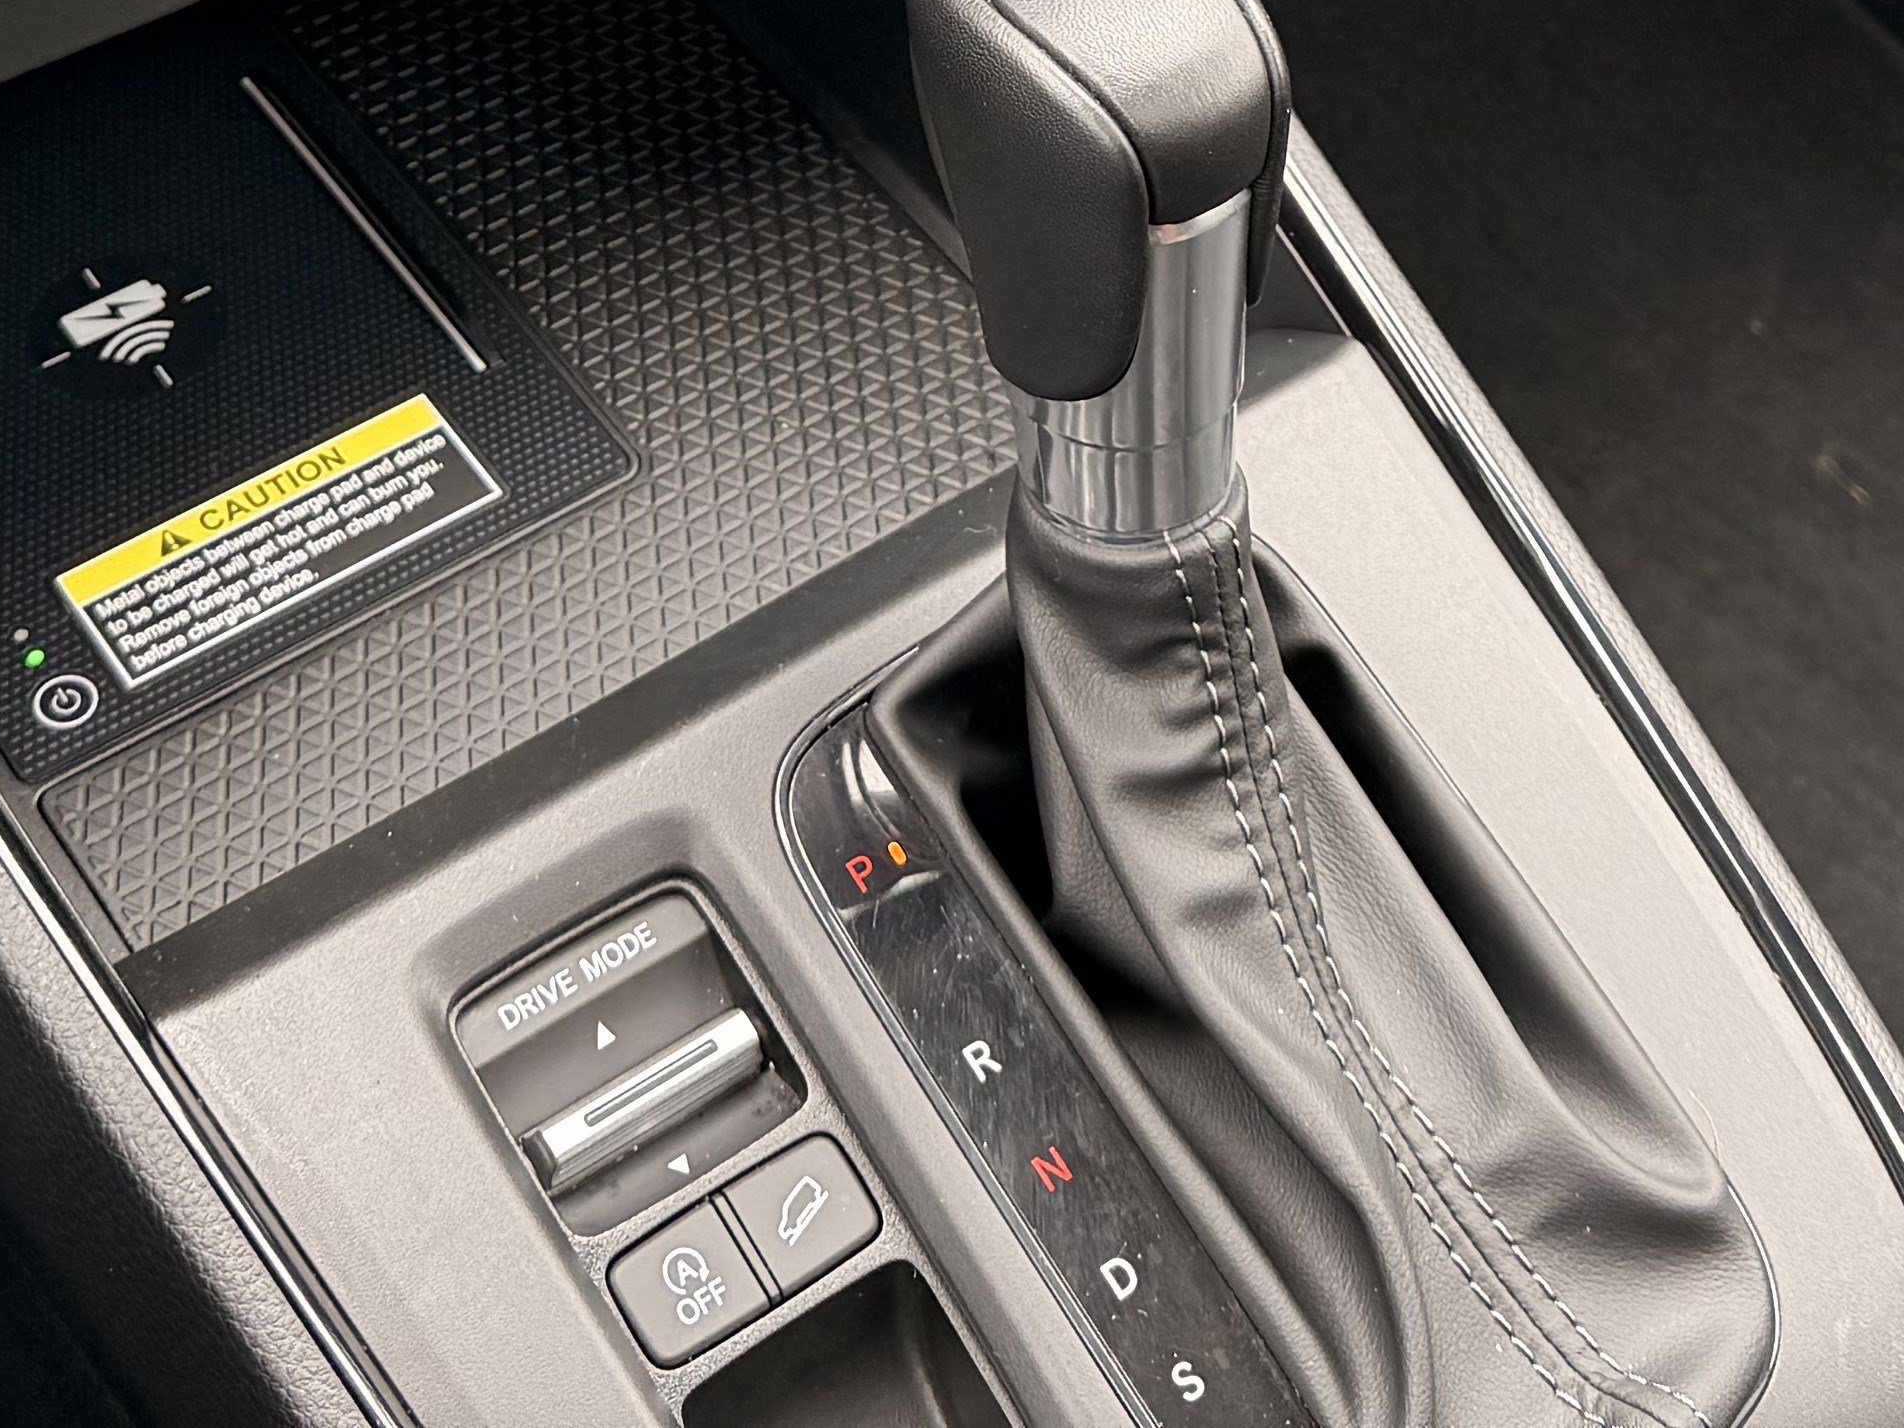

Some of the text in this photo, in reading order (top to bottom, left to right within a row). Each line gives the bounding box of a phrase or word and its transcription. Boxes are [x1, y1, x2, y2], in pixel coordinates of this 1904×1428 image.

[199, 446, 348, 531] CAUTION
[95, 434, 446, 620] Metal objects between charge pad and device
[106, 459, 444, 636] to be charged will get hot and can burn you.
[119, 481, 435, 653] Remove foreign objects from charge pad
[131, 634, 188, 671] before
[187, 596, 262, 643] charging
[844, 854, 876, 893] P
[496, 920, 659, 1032] DRIVE MODE
[961, 1040, 1003, 1084] R
[1031, 1147, 1072, 1191] N
[676, 1280, 728, 1327] OFF
[1099, 1256, 1140, 1302] D
[1171, 1360, 1207, 1403] S
